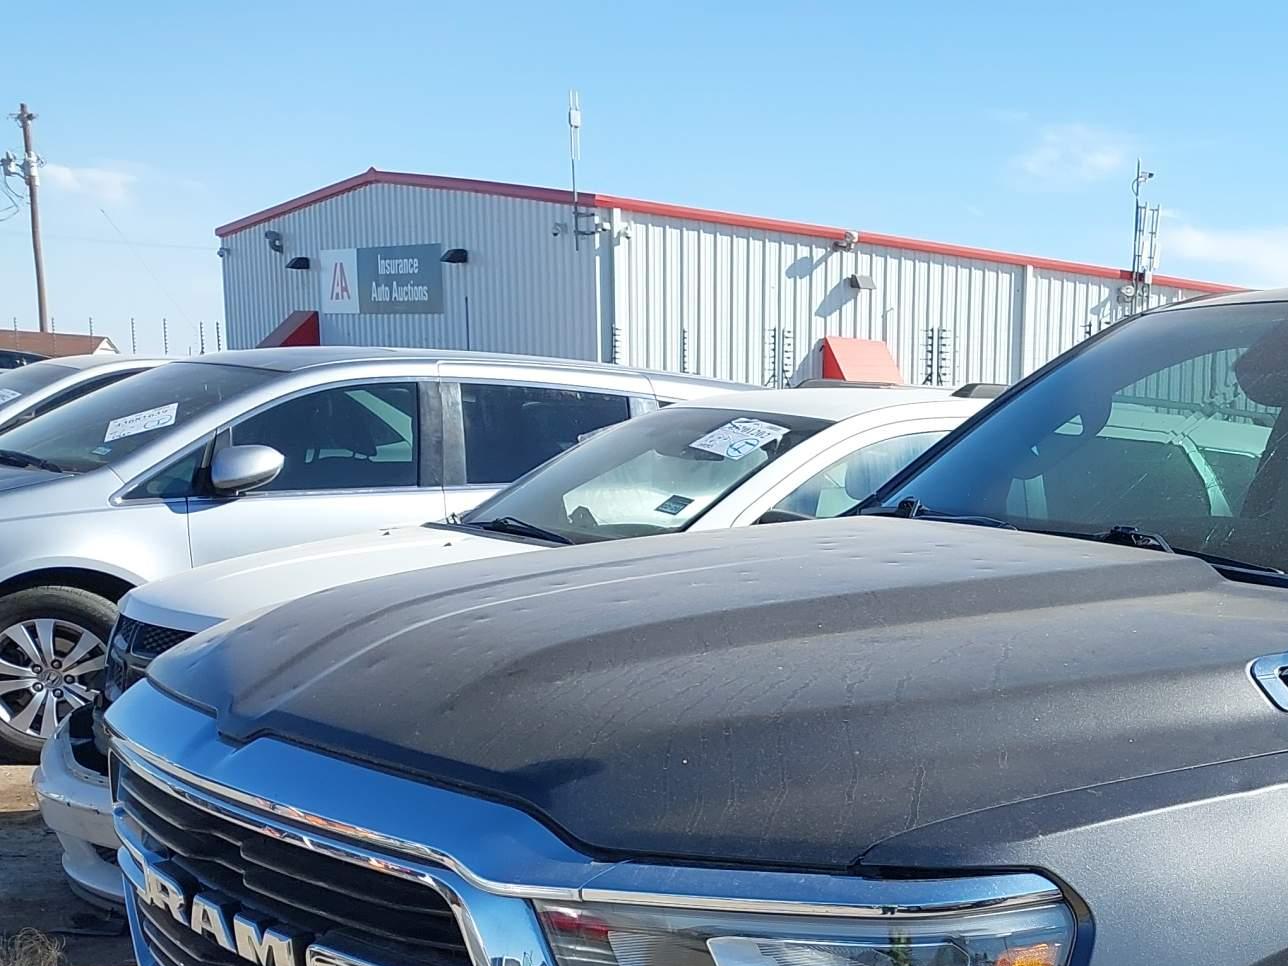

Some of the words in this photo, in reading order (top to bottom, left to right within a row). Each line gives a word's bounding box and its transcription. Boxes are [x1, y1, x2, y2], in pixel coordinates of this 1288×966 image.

[377, 254, 419, 275] Insurance
[371, 281, 390, 302] Auto
[392, 280, 429, 302] Auctions
